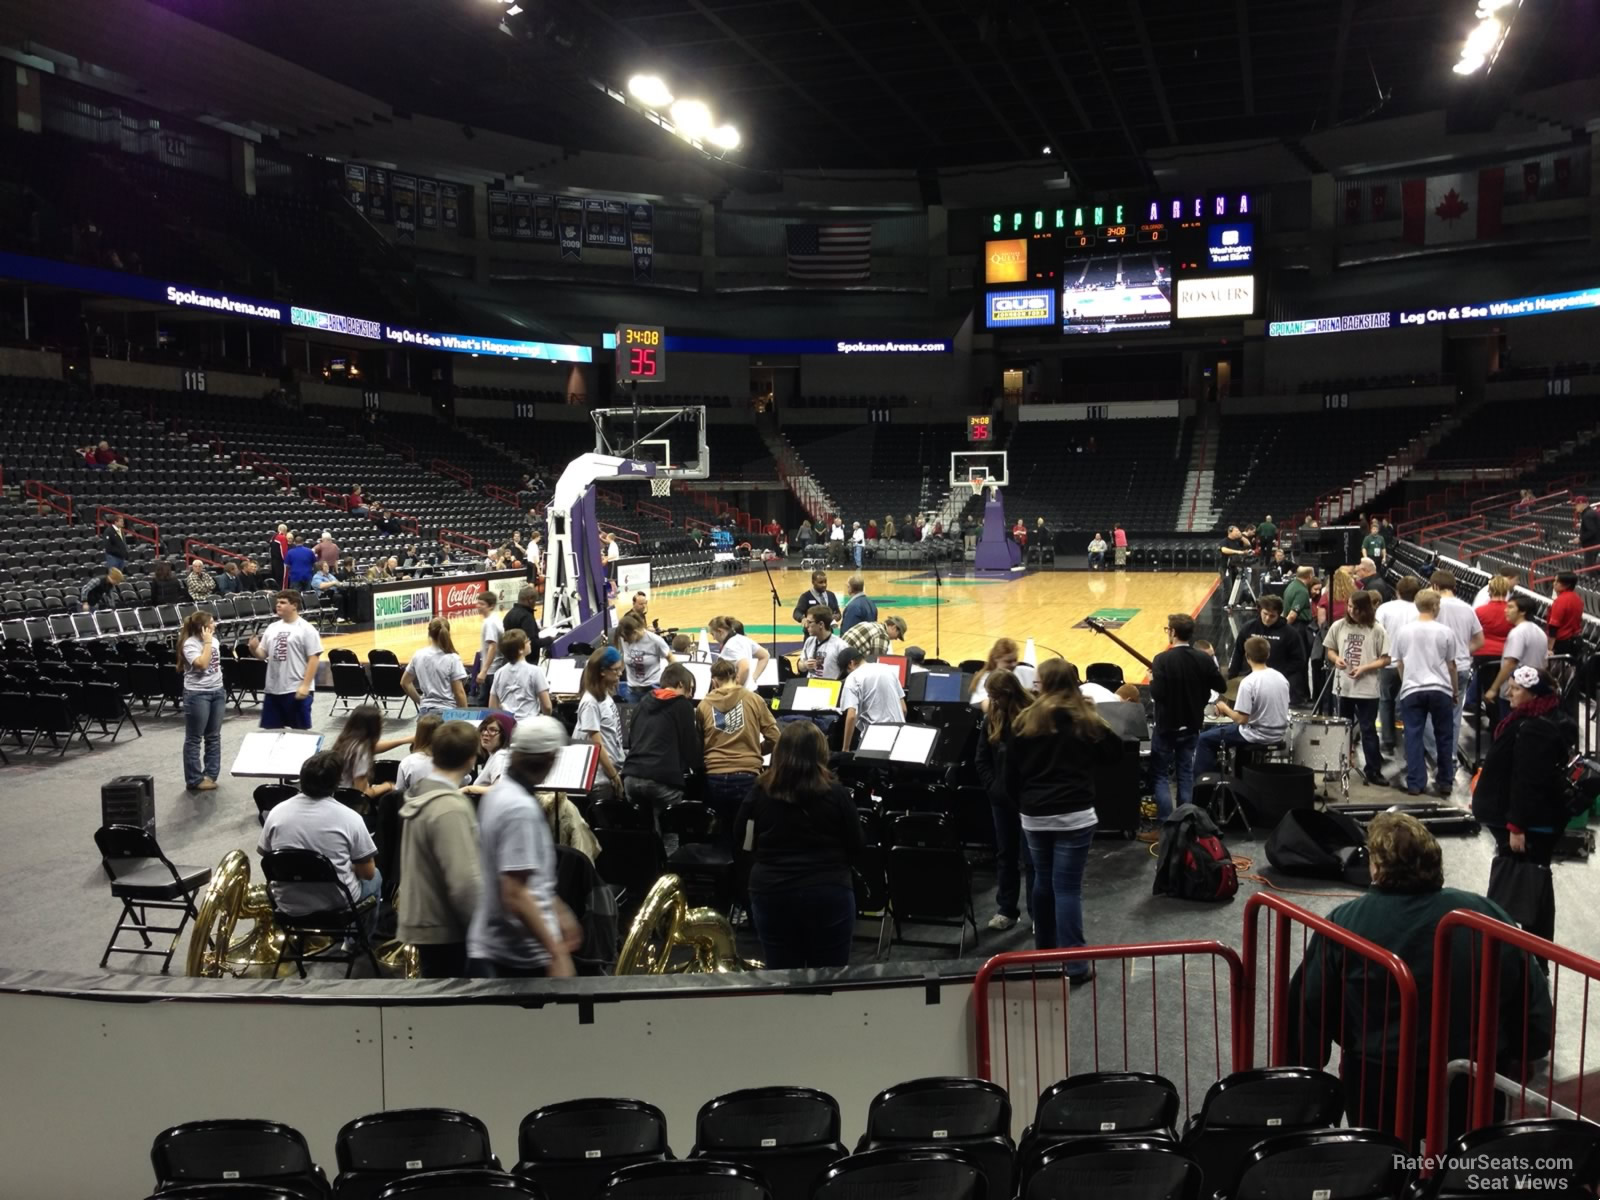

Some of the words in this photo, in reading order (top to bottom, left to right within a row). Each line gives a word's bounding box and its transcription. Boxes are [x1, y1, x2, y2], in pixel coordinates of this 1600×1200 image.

[993, 206, 1123, 232] SPOKANE
[1150, 195, 1247, 220] ARENA
[609, 235, 624, 243] 2010
[1081, 237, 1086, 246] 0
[1152, 232, 1158, 240] 0
[562, 240, 580, 248] 2009
[633, 246, 652, 255] 2010
[1209, 246, 1252, 256] Washington
[1211, 254, 1230, 262] Trust
[1230, 253, 1249, 261] Bank
[1182, 288, 1248, 303] ROSAUERS
[167, 286, 280, 320] SpokaneArena.com
[1400, 312, 1425, 325] Log
[1426, 310, 1446, 321] On
[1448, 308, 1459, 319] &
[1461, 306, 1488, 318] See
[1489, 302, 1534, 315] What's
[328, 313, 347, 333] ARENA
[347, 317, 380, 339] BACKSTAGE
[1269, 322, 1304, 336] SPOKANE
[1317, 318, 1341, 332] ARENA
[1342, 313, 1390, 331] BACKSTAGE
[386, 326, 403, 343] Log
[403, 330, 415, 342] On
[416, 332, 422, 344] &
[423, 334, 441, 347] See
[442, 336, 481, 350] What's
[626, 329, 659, 345] 34:08
[837, 342, 945, 353] SpokaneArena.com
[630, 348, 656, 375] 35
[184, 371, 205, 391] 115
[1548, 379, 1571, 395] 108
[364, 391, 380, 408] 114
[1325, 394, 1348, 408] 109
[516, 404, 534, 418] 113
[871, 409, 889, 422] 111
[1088, 406, 1107, 419] 110
[971, 417, 989, 425] 34:08
[973, 426, 987, 439] 35
[376, 595, 402, 617] SPOKANE
[412, 592, 430, 611] ARENA
